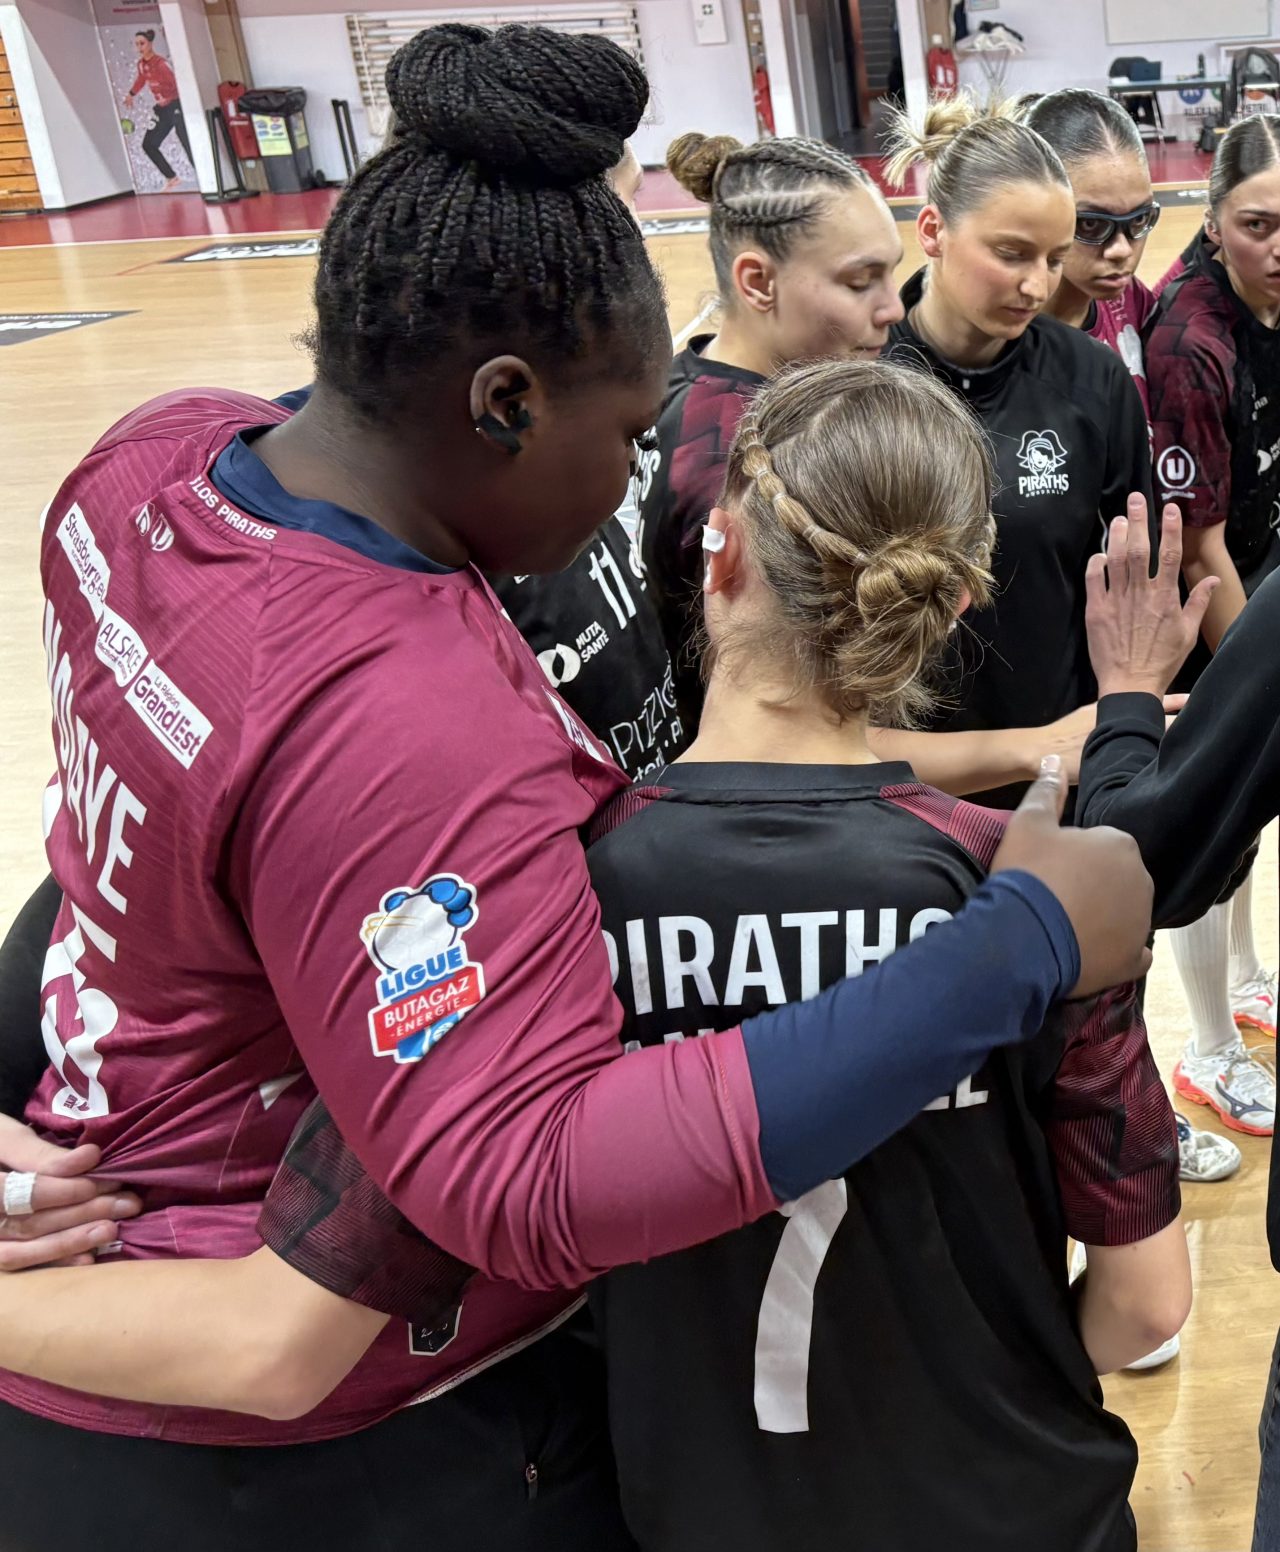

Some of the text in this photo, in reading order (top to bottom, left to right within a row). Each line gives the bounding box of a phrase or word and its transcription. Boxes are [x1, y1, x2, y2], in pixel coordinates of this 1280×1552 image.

[1018, 474, 1070, 495] PIRATHS
[1166, 458, 1185, 480] U
[216, 504, 278, 540] PIRATHS
[588, 541, 637, 630] 11
[575, 620, 602, 650] MUTA
[380, 946, 464, 999] LIGUE
[384, 975, 470, 1029] BUTAGAZ
